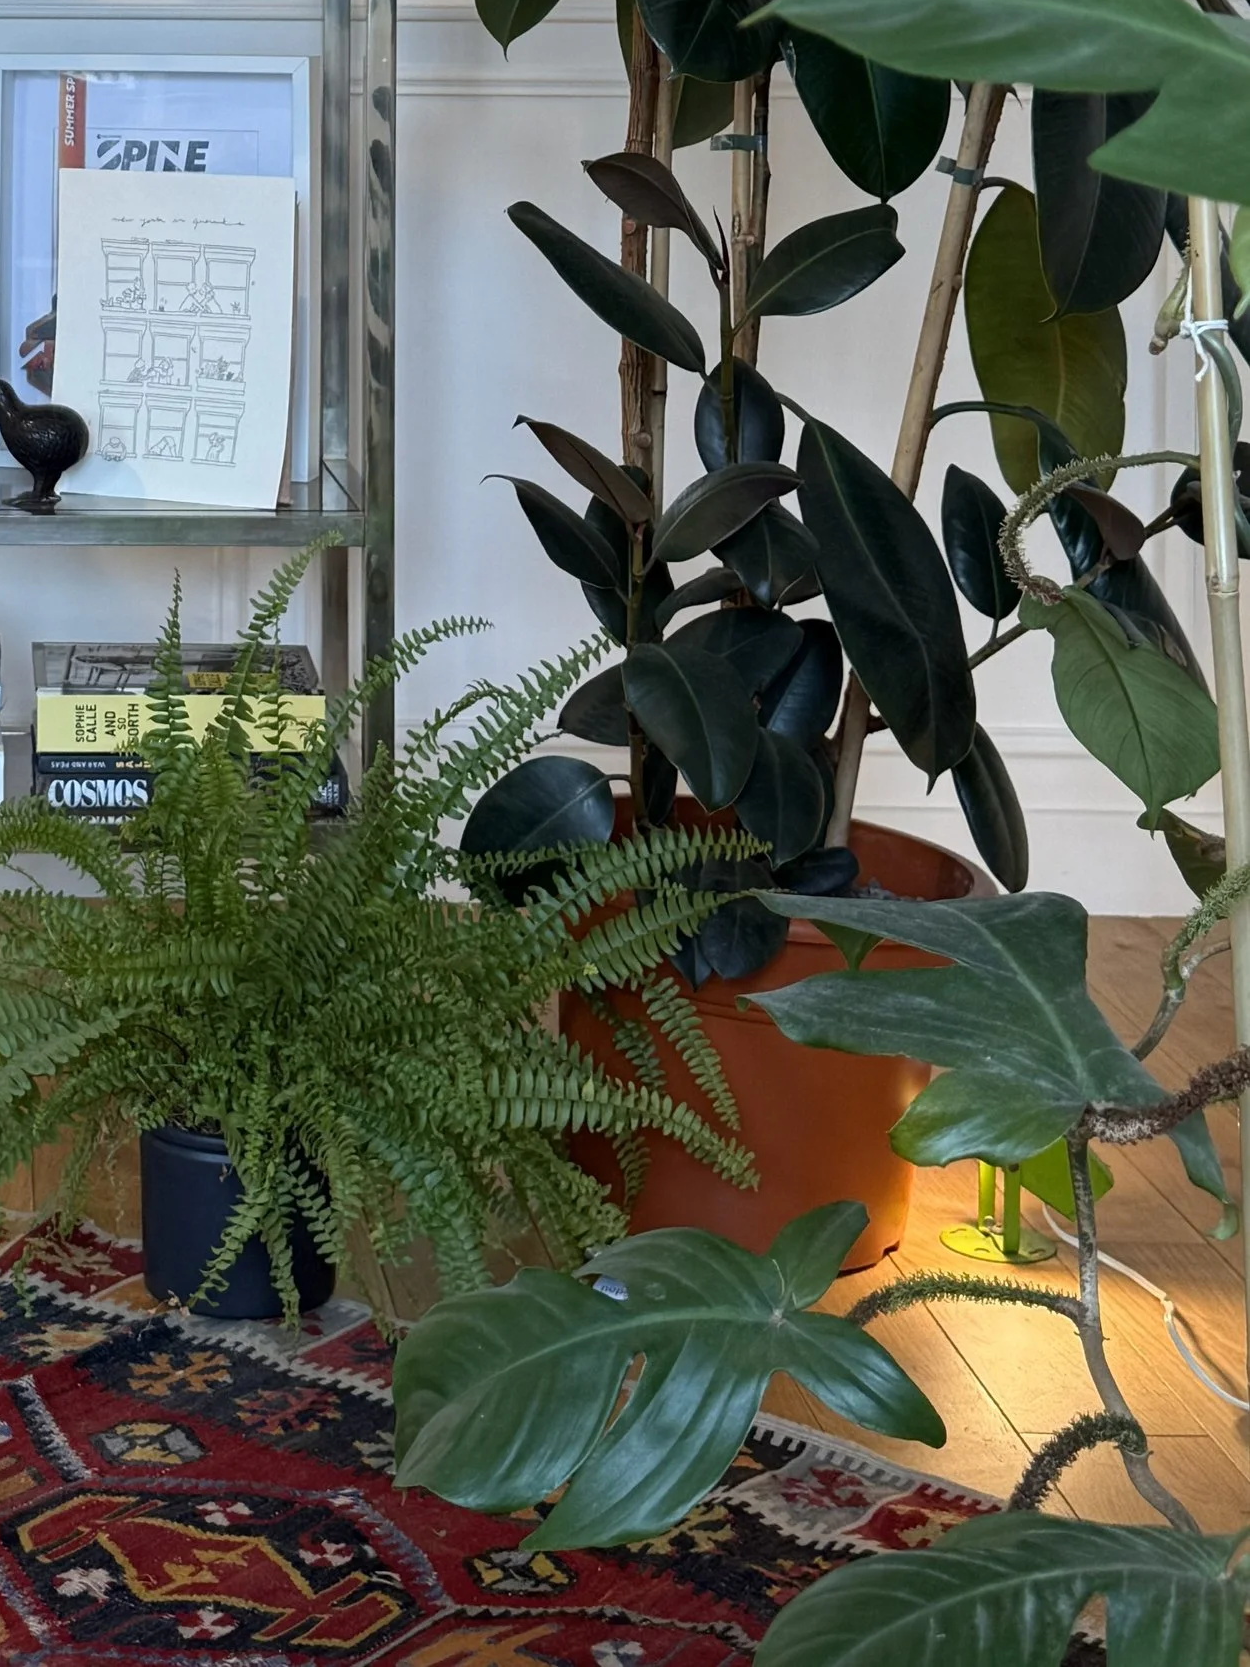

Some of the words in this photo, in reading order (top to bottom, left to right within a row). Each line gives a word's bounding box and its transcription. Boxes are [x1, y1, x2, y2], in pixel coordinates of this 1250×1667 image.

[64, 94, 75, 147] SUMMER
[75, 703, 85, 743] SOPHIE
[86, 703, 97, 743] CALLE
[104, 710, 116, 737] AND
[117, 717, 126, 731] SO
[47, 779, 149, 808] COSMOS
